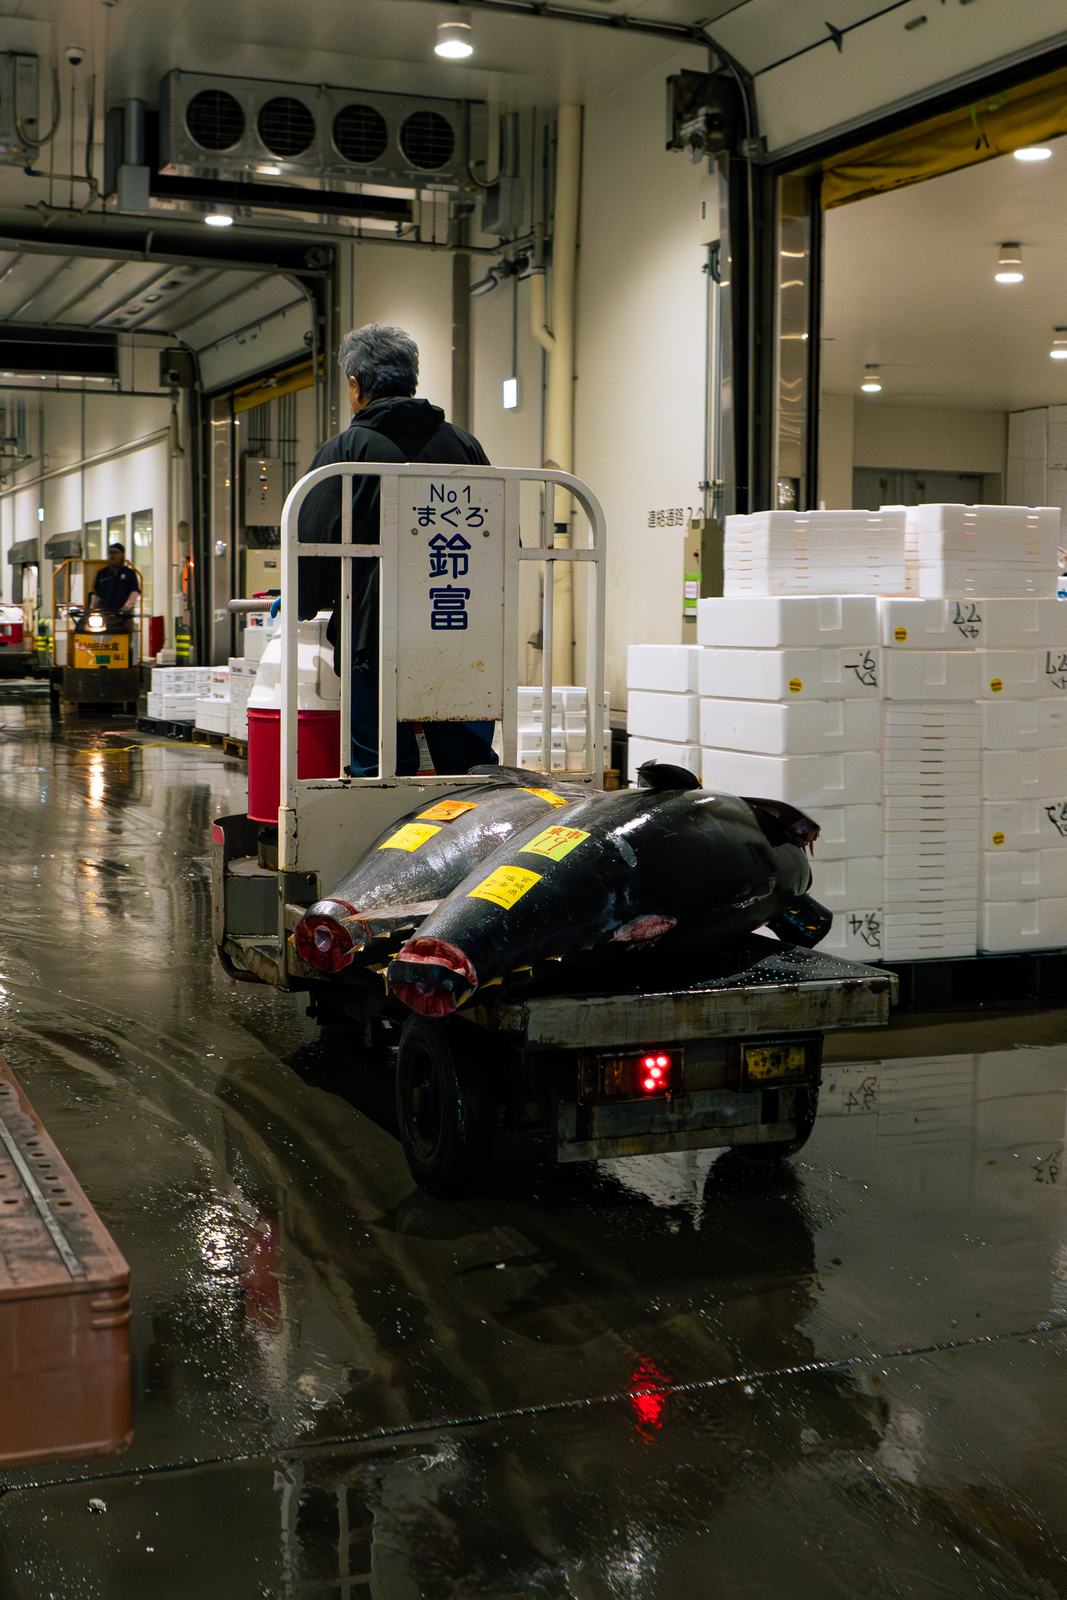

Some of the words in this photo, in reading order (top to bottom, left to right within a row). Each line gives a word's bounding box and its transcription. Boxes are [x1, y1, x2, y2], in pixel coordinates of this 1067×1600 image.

[417, 505, 485, 528] まぐろ
[428, 533, 472, 630] 鈴富
